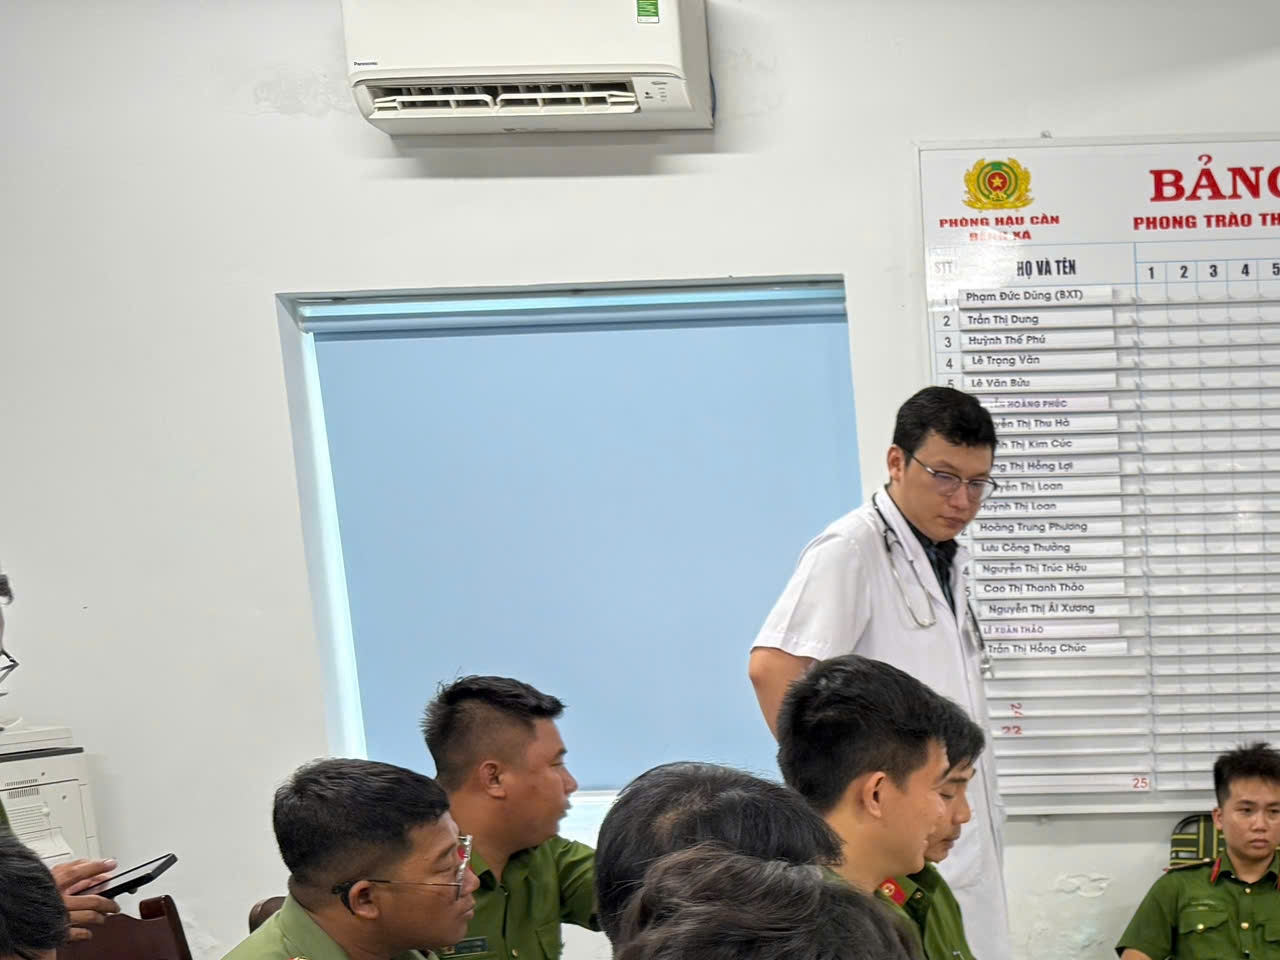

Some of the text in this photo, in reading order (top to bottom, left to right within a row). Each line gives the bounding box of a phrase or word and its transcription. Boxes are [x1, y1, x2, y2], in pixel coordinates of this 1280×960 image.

[939, 216, 990, 228] PHÒNG
[995, 215, 1025, 229] HẬU
[1133, 215, 1197, 231] PHONG
[1204, 211, 1252, 229] TRÀO
[1016, 257, 1077, 279] HỌ VÀ TÊN
[1179, 266, 1188, 278] 2
[1209, 265, 1218, 277] 3
[1241, 264, 1250, 277] 4
[1272, 263, 1280, 276] 5
[966, 291, 996, 302] Phạm
[1055, 289, 1083, 301] (BXT)
[943, 315, 951, 327] 2
[993, 315, 1009, 326] Thị
[1011, 315, 1039, 326] Dung
[944, 337, 952, 348] 3
[945, 358, 953, 369] 4
[1034, 419, 1053, 428] Thu
[1028, 439, 1048, 448] Kim
[1038, 481, 1063, 491] Loan
[1031, 502, 1057, 511] Loan
[1017, 523, 1046, 534] Trung
[983, 584, 1006, 594] Cao
[1026, 584, 1057, 593] Thanh
[1132, 777, 1149, 789] 25
